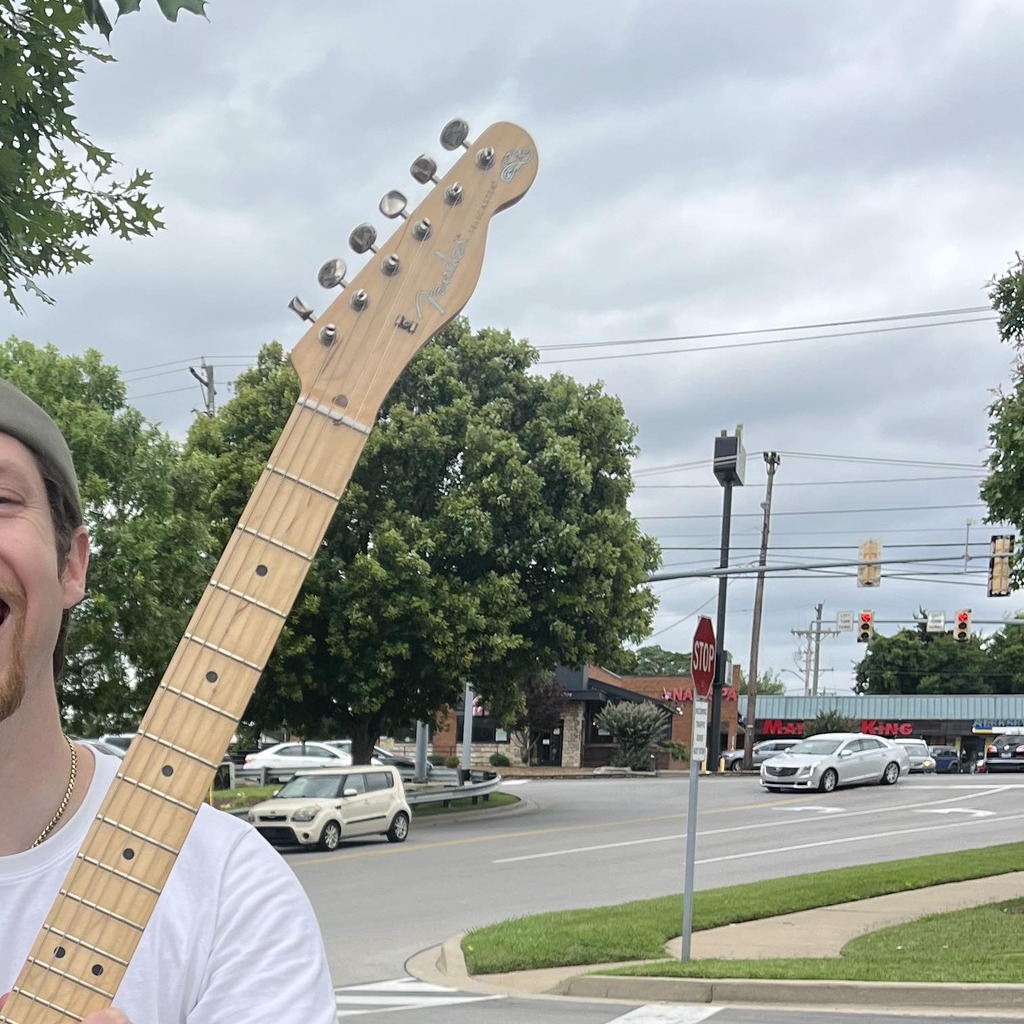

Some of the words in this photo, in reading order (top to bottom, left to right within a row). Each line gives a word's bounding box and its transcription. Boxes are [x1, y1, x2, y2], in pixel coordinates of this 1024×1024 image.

[416, 239, 469, 319] Fender
[693, 641, 714, 673] STOP
[861, 719, 913, 735] KING
